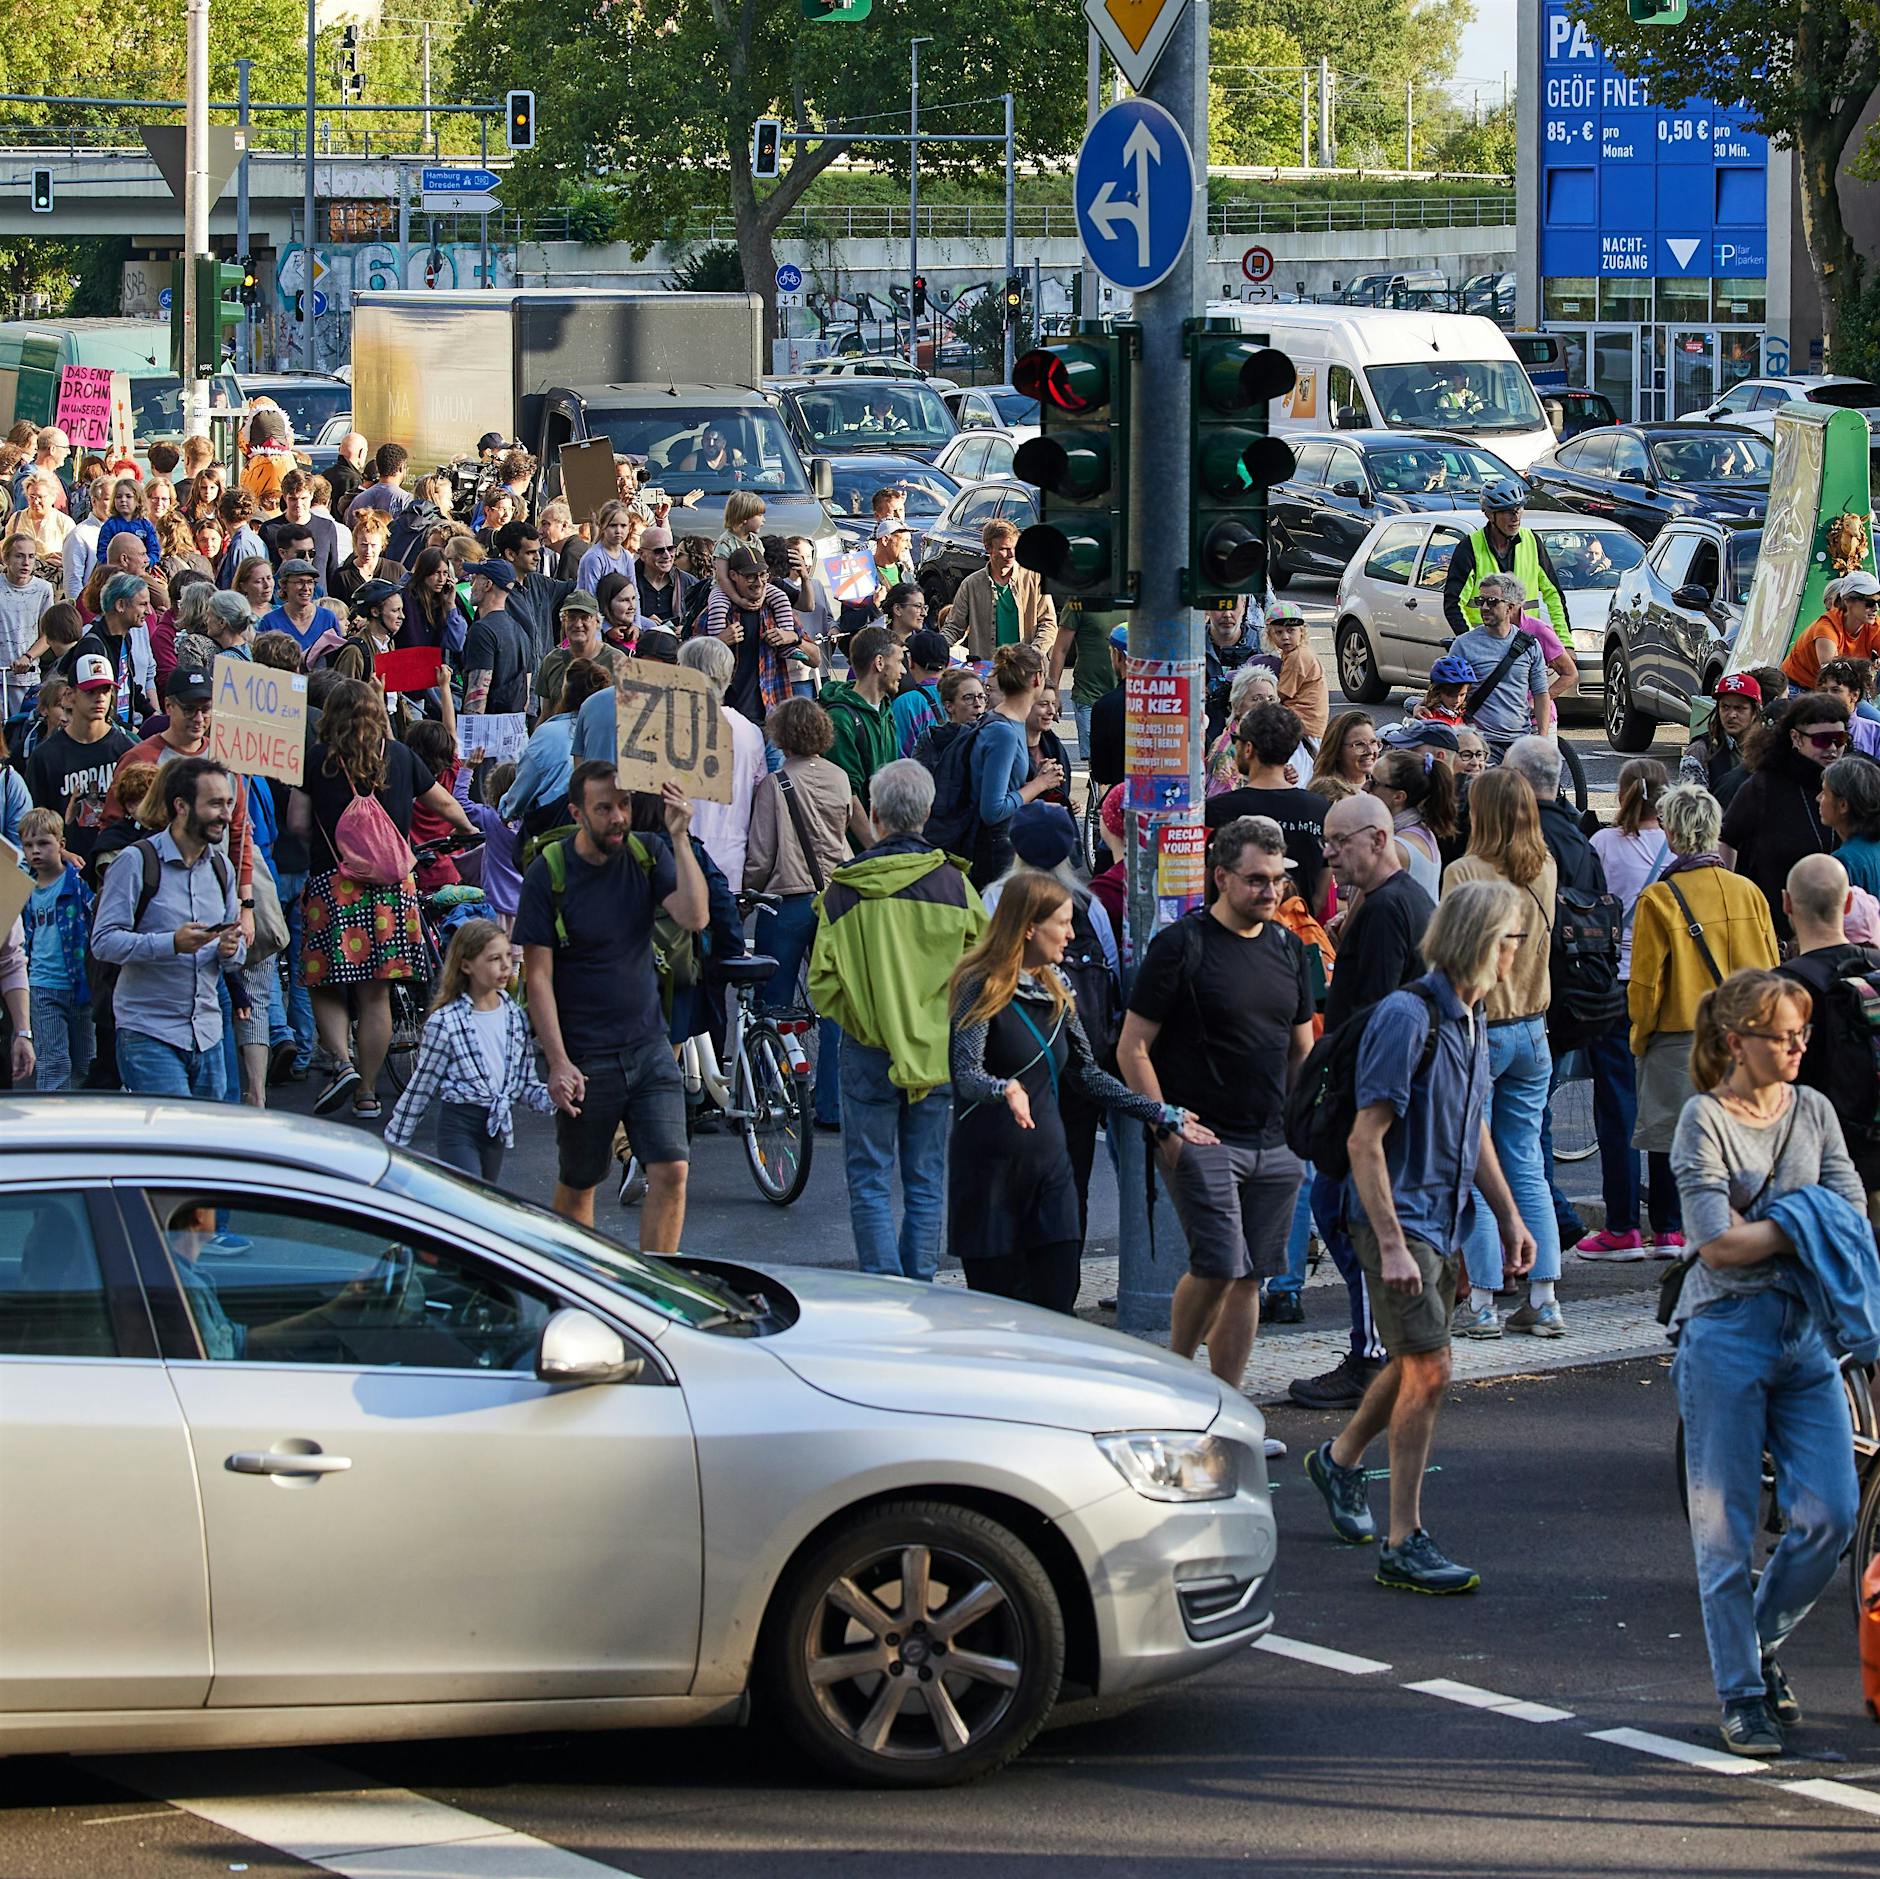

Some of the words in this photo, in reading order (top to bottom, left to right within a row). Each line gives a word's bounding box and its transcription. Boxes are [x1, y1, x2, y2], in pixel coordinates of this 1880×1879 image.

[1547, 121, 1578, 144] 85,-
[1582, 121, 1594, 142] €
[1603, 127, 1620, 141] pro
[1658, 120, 1693, 144] 0,50
[1696, 120, 1709, 140] €
[1714, 126, 1731, 140] pro
[1603, 144, 1634, 158] Monat
[1714, 144, 1726, 158] 30
[1728, 143, 1751, 158] Min.
[426, 171, 460, 181] Hamburg
[428, 181, 460, 189] Dresden
[1602, 237, 1647, 252] NACHT-
[1738, 244, 1751, 254] fair
[1602, 254, 1648, 270] ZUGANG
[1738, 255, 1764, 266] parken
[66, 366, 88, 379] DAS
[61, 403, 70, 414] IN
[70, 404, 108, 417] UNSEREN
[58, 417, 108, 441] OHREN
[219, 665, 239, 705] A
[244, 675, 279, 715] 100
[1147, 698, 1182, 714] KIEZ
[620, 678, 720, 778] ZU!
[214, 723, 300, 775] RADWEG
[1163, 842, 1191, 853] YOUR
